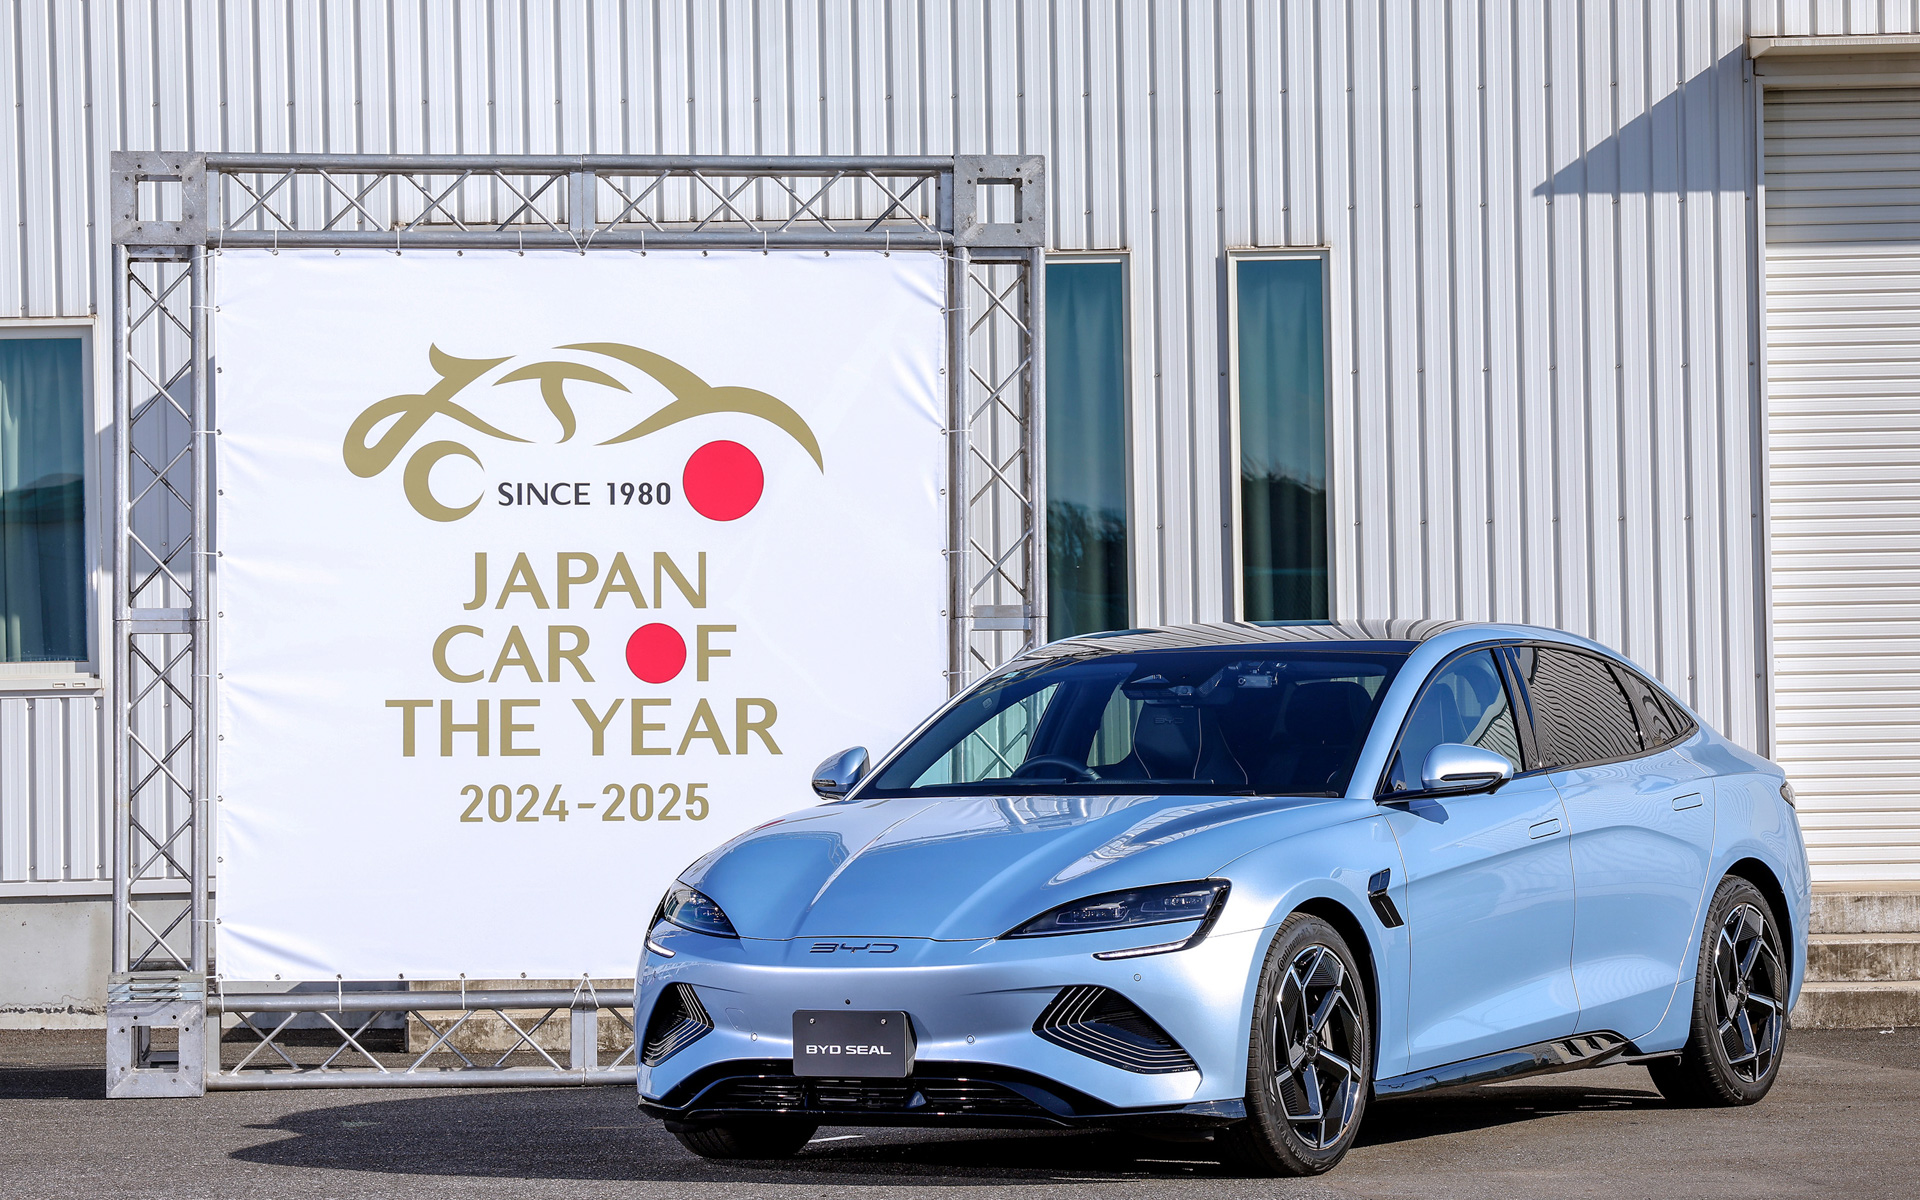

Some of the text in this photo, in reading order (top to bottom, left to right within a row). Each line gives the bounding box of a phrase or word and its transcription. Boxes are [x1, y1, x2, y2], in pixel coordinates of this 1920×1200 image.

[498, 482, 671, 506] SINCE 1980
[462, 551, 707, 611] JAPAN
[432, 624, 596, 684] CAR
[385, 697, 783, 757] THE YEAR
[459, 782, 710, 823] 2024-2025
[809, 942, 900, 954] BYD
[1704, 936, 1717, 997] Continental
[805, 1044, 892, 1055] BYD SEAL
